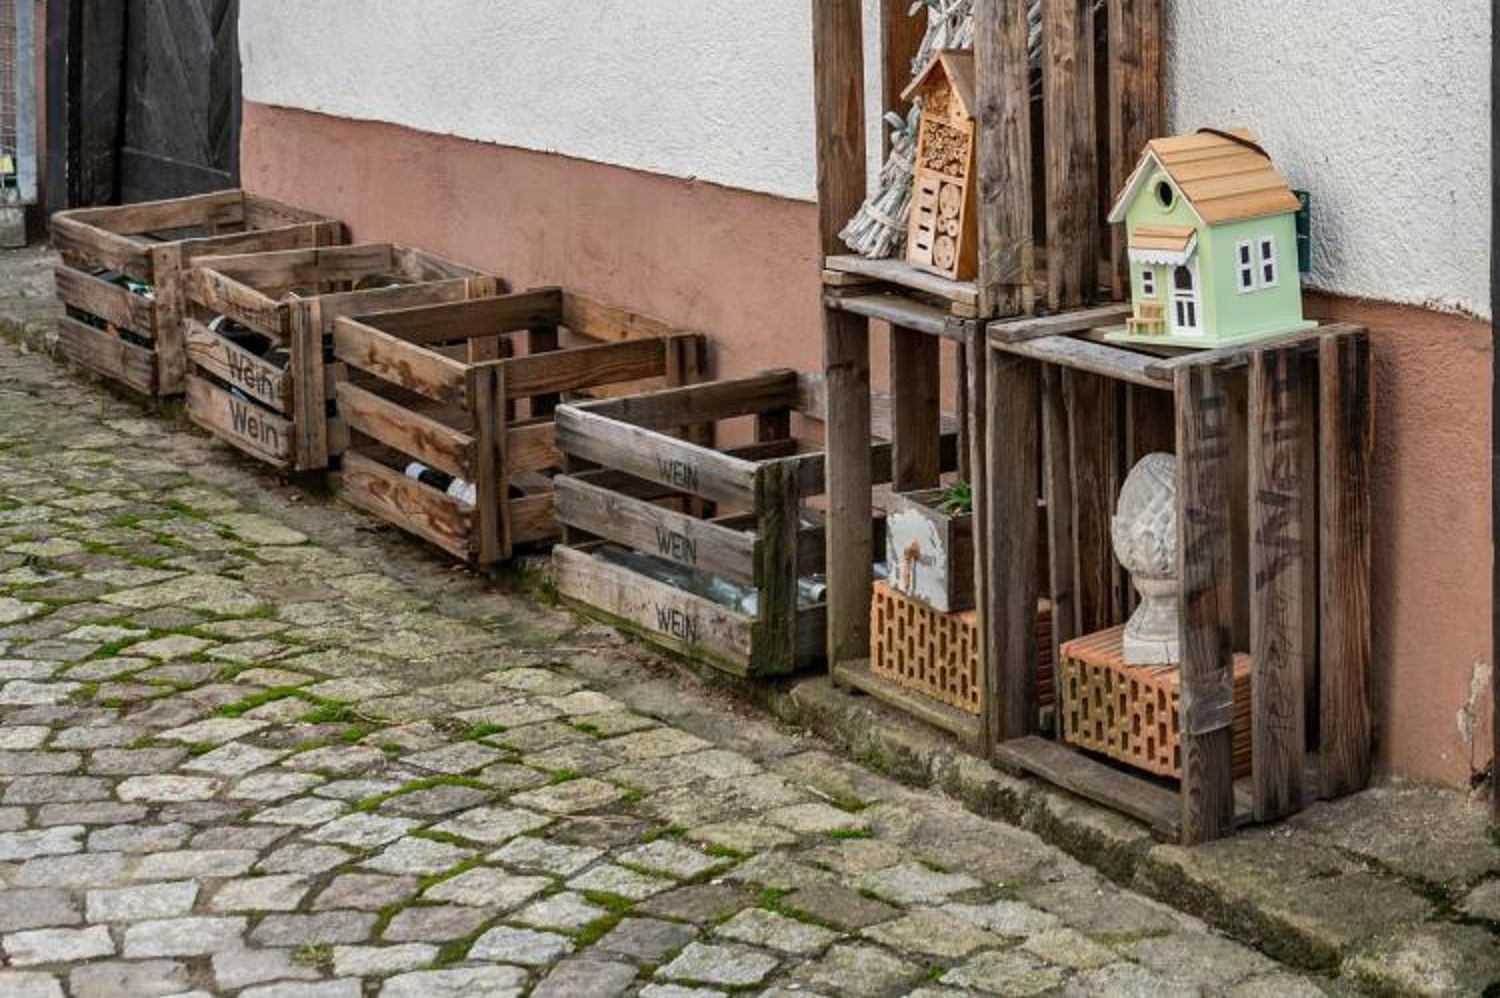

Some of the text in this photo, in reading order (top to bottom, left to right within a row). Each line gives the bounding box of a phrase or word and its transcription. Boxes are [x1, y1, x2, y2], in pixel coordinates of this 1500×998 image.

[225, 346, 274, 398] Wein
[229, 400, 280, 449] Wein
[656, 457, 699, 490] WEIN
[655, 526, 697, 565] WEIN
[655, 603, 698, 644] WEIN
